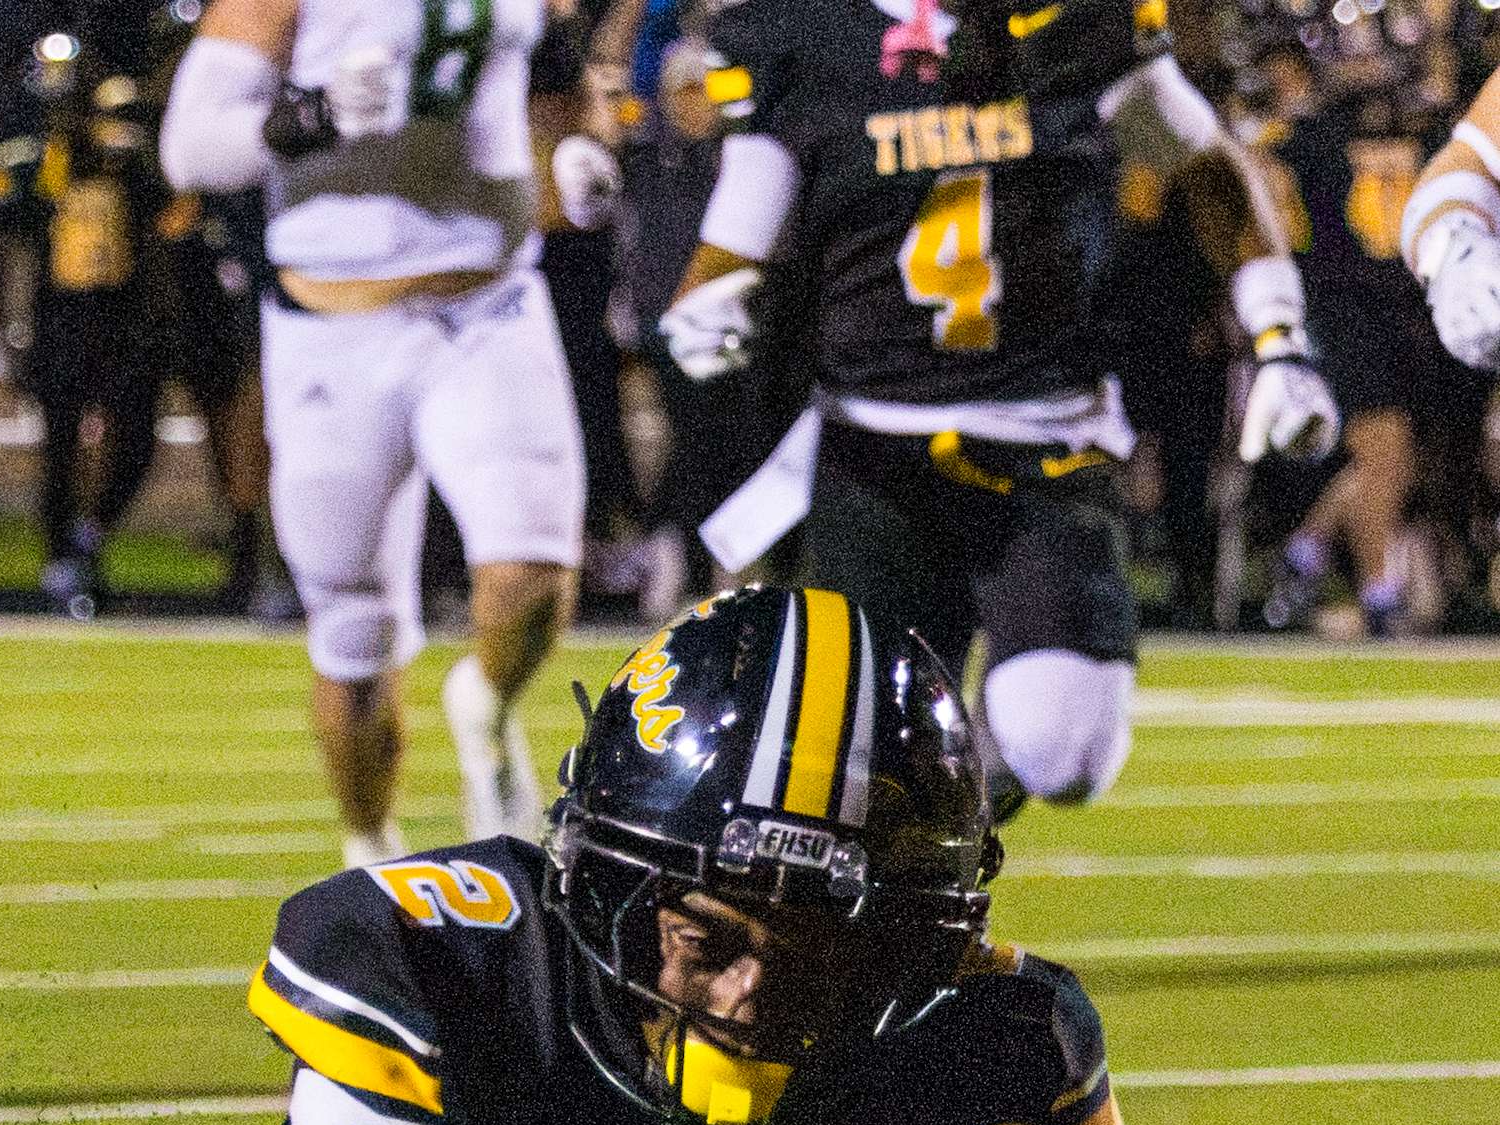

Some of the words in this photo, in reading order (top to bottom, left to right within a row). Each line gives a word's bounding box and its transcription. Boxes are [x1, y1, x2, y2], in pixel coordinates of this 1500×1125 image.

[864, 96, 1033, 176] TIGERS
[896, 168, 1004, 350] 4
[364, 860, 521, 930] 2
